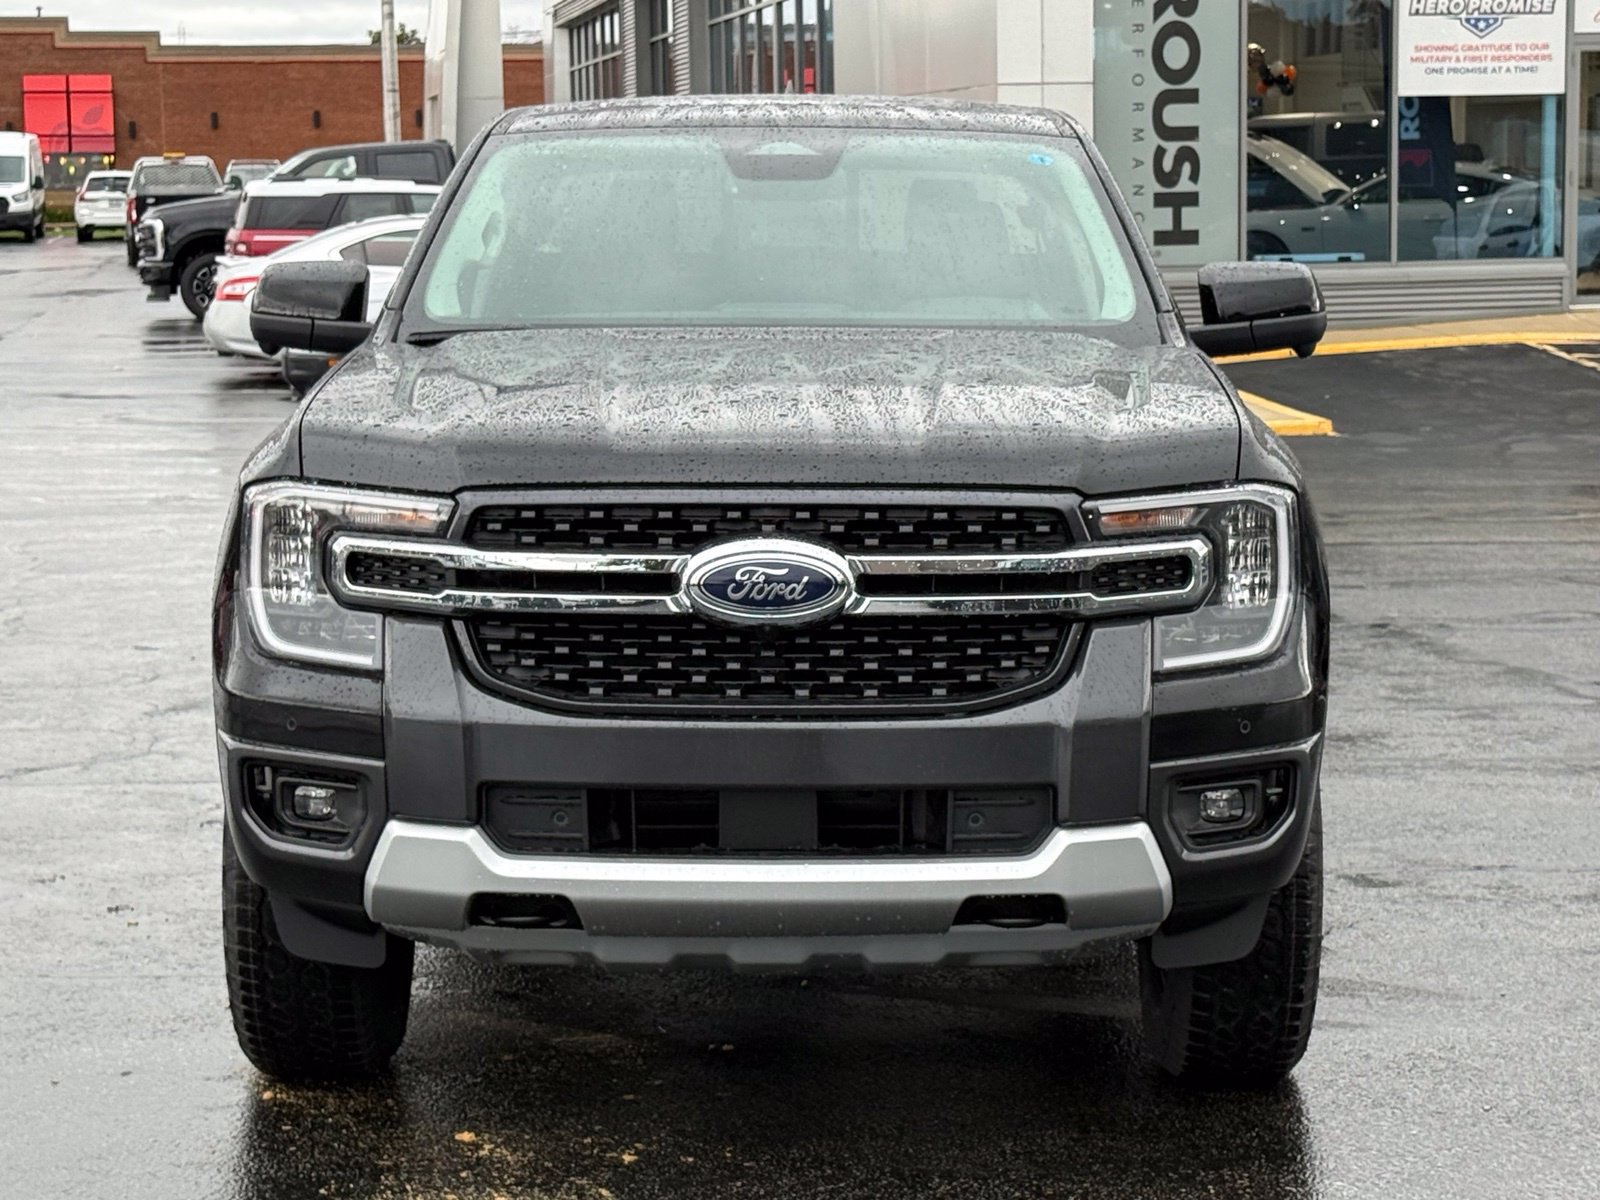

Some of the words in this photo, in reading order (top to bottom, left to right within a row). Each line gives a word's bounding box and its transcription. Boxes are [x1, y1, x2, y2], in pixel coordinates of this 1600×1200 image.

[1408, 0, 1465, 15] HERO
[1466, 0, 1555, 15] PROMISE
[1413, 44, 1459, 53] SHOWING
[1460, 43, 1513, 52] GRATITUDE
[1515, 42, 1528, 51] TO
[1529, 42, 1550, 51] OUR
[1410, 55, 1453, 63] MILITARY
[1454, 55, 1461, 63] &
[1463, 55, 1488, 63] FIRST
[1490, 54, 1553, 62] RESPONDERS
[1424, 66, 1445, 75] ONE
[1447, 66, 1489, 75] PROMISE
[1490, 65, 1503, 74] AT
[1504, 65, 1512, 74] A
[727, 566, 809, 601] Ford
